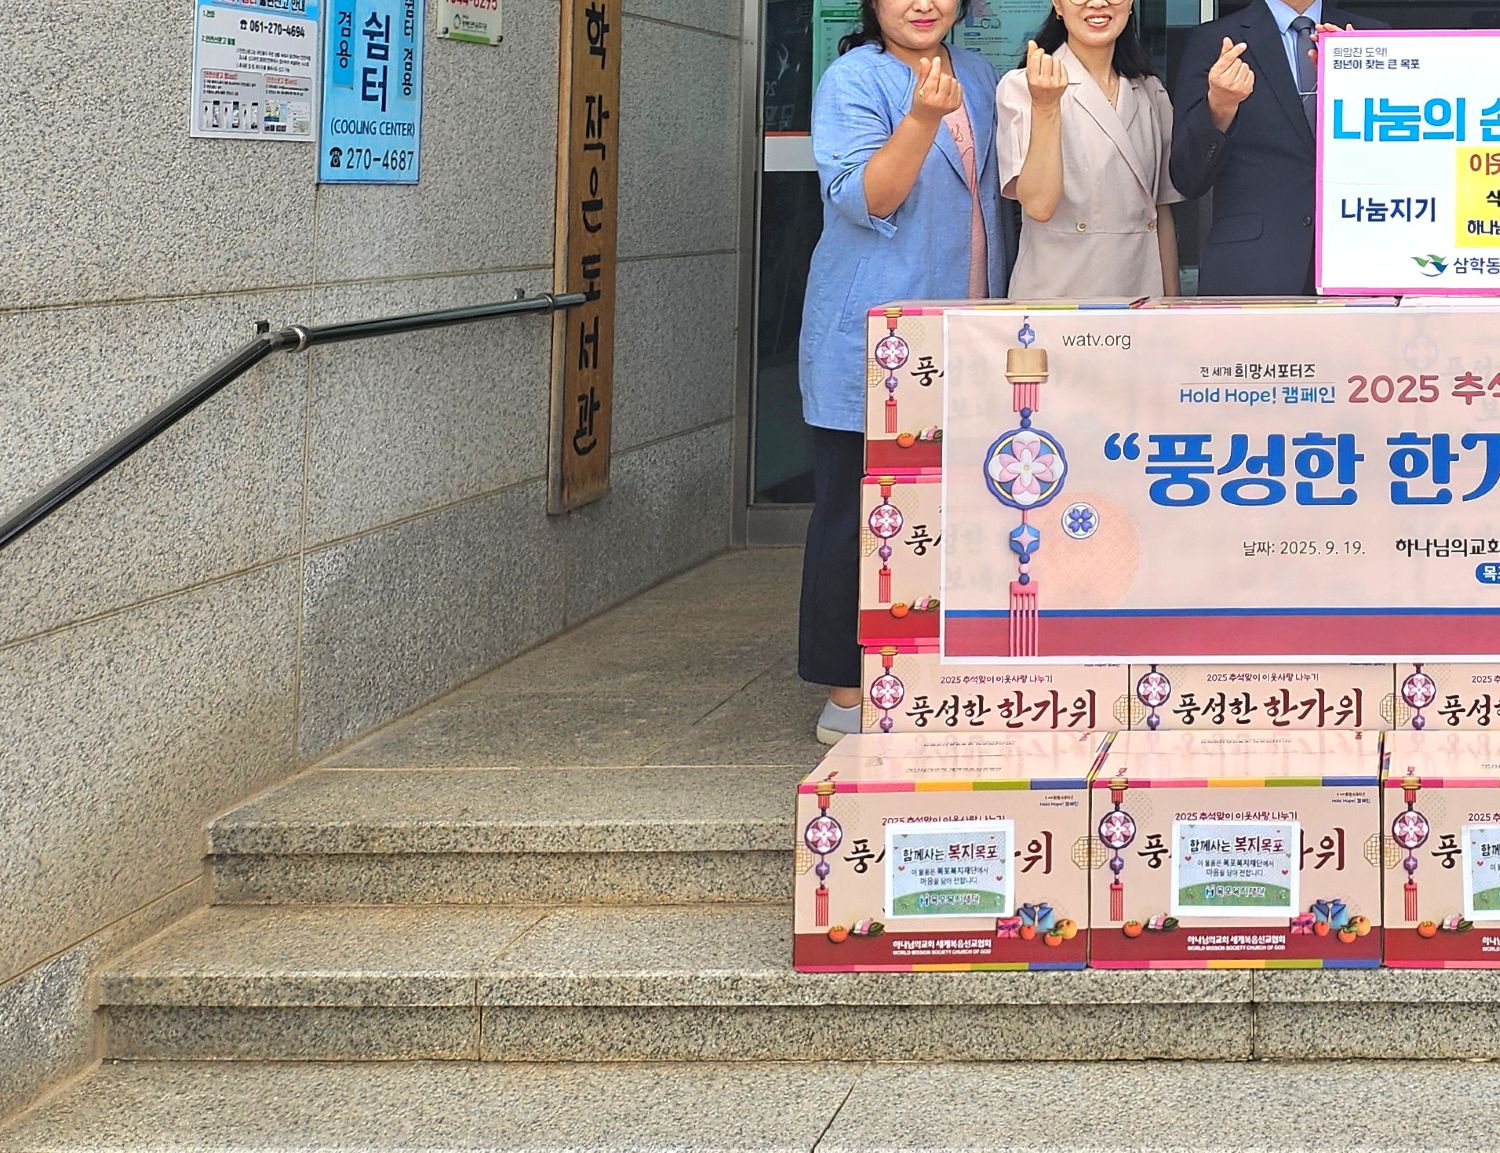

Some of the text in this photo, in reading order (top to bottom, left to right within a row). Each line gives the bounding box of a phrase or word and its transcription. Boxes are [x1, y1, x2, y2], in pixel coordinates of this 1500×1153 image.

[336, 11, 352, 69] 겸용
[361, 11, 390, 112] 쉼터
[1387, 59, 1397, 69] 큰
[1400, 59, 1420, 69] 목포
[331, 117, 415, 138] (COOLING CENTER)
[1333, 97, 1466, 142] 나눔의
[347, 148, 414, 172] 270-4687
[1341, 197, 1436, 223] 나눔지기
[1062, 332, 1131, 350] watv.org
[1200, 363, 1317, 379] 전 세계 희망서포터즈
[1180, 385, 1336, 407] Hold Hope! 캠페인
[1347, 374, 1440, 405] 2025
[1242, 540, 1366, 557] 날짜: 2025. 9. 19.
[940, 675, 961, 684] 2025
[1030, 675, 1053, 684] 나누기
[1207, 673, 1228, 682] 2025
[1296, 673, 1319, 682] 나누기
[1471, 675, 1492, 684] 2025
[905, 689, 1096, 729] 풍성한 한가위
[1172, 688, 1363, 728] 풍성한 한가위
[1175, 812, 1297, 821] 2025 추석맞이 이웃사랑 나누기
[1468, 813, 1491, 822] 2025
[903, 848, 944, 862] 함께사는
[948, 842, 998, 860] 복지목포
[1190, 836, 1284, 853] 함께사는 복지목포
